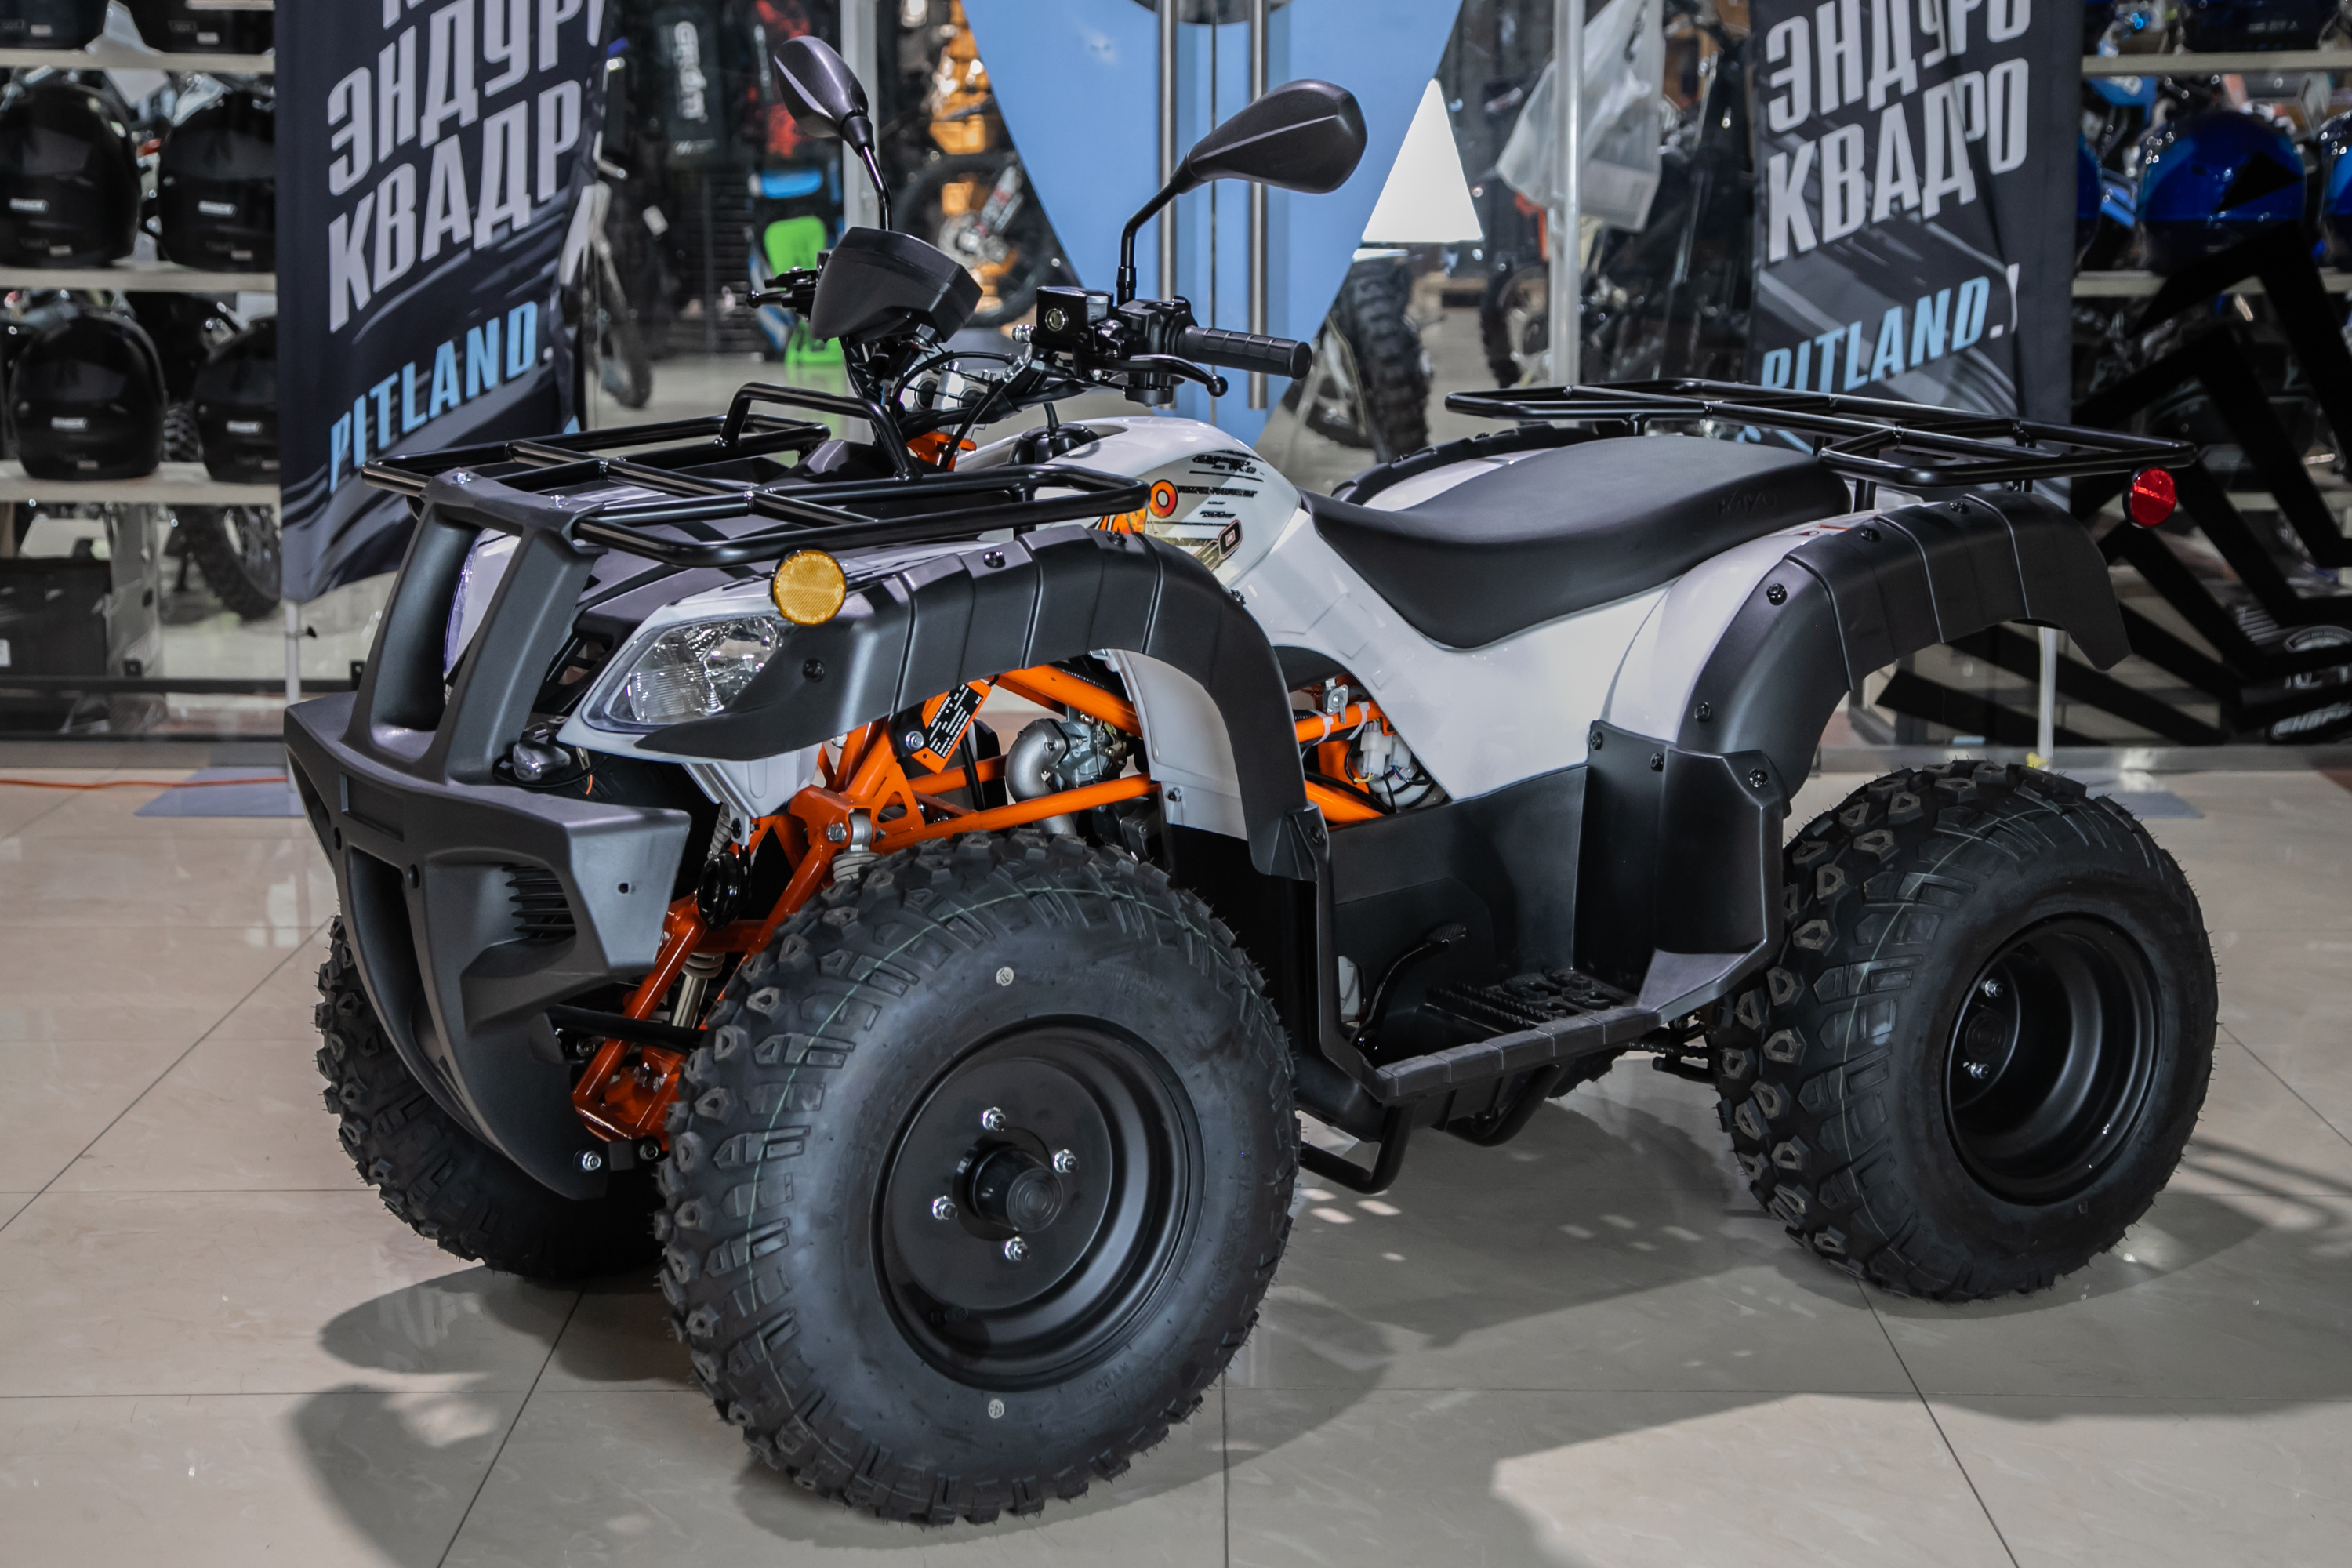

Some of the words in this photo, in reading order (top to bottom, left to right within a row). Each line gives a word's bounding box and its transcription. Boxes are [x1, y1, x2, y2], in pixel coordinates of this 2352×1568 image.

[328, 0, 606, 195] ЭНДУР
[1768, 57, 2029, 263] КВАДРО
[329, 80, 581, 333] КВАДР
